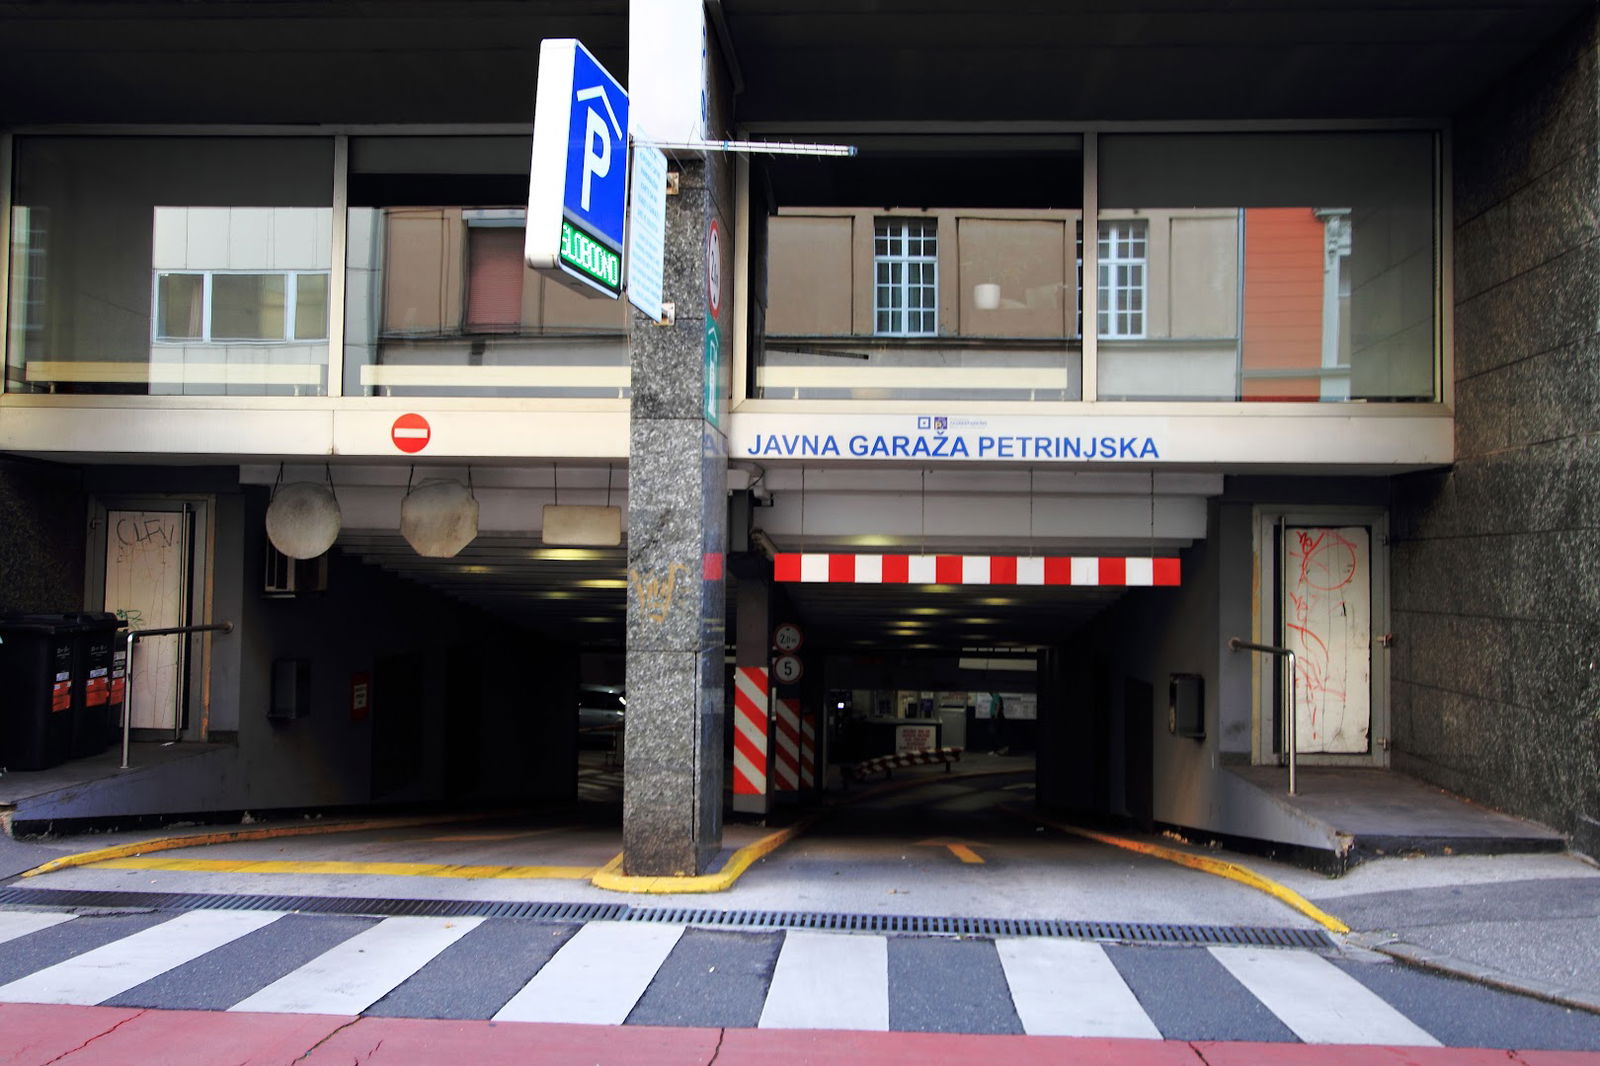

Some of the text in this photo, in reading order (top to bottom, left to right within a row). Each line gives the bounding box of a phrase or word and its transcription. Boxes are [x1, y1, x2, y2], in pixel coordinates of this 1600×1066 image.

[581, 106, 611, 213] P
[748, 432, 1160, 459] JAVNA GARAŽA PETRINJSKA
[784, 661, 792, 676] 5
